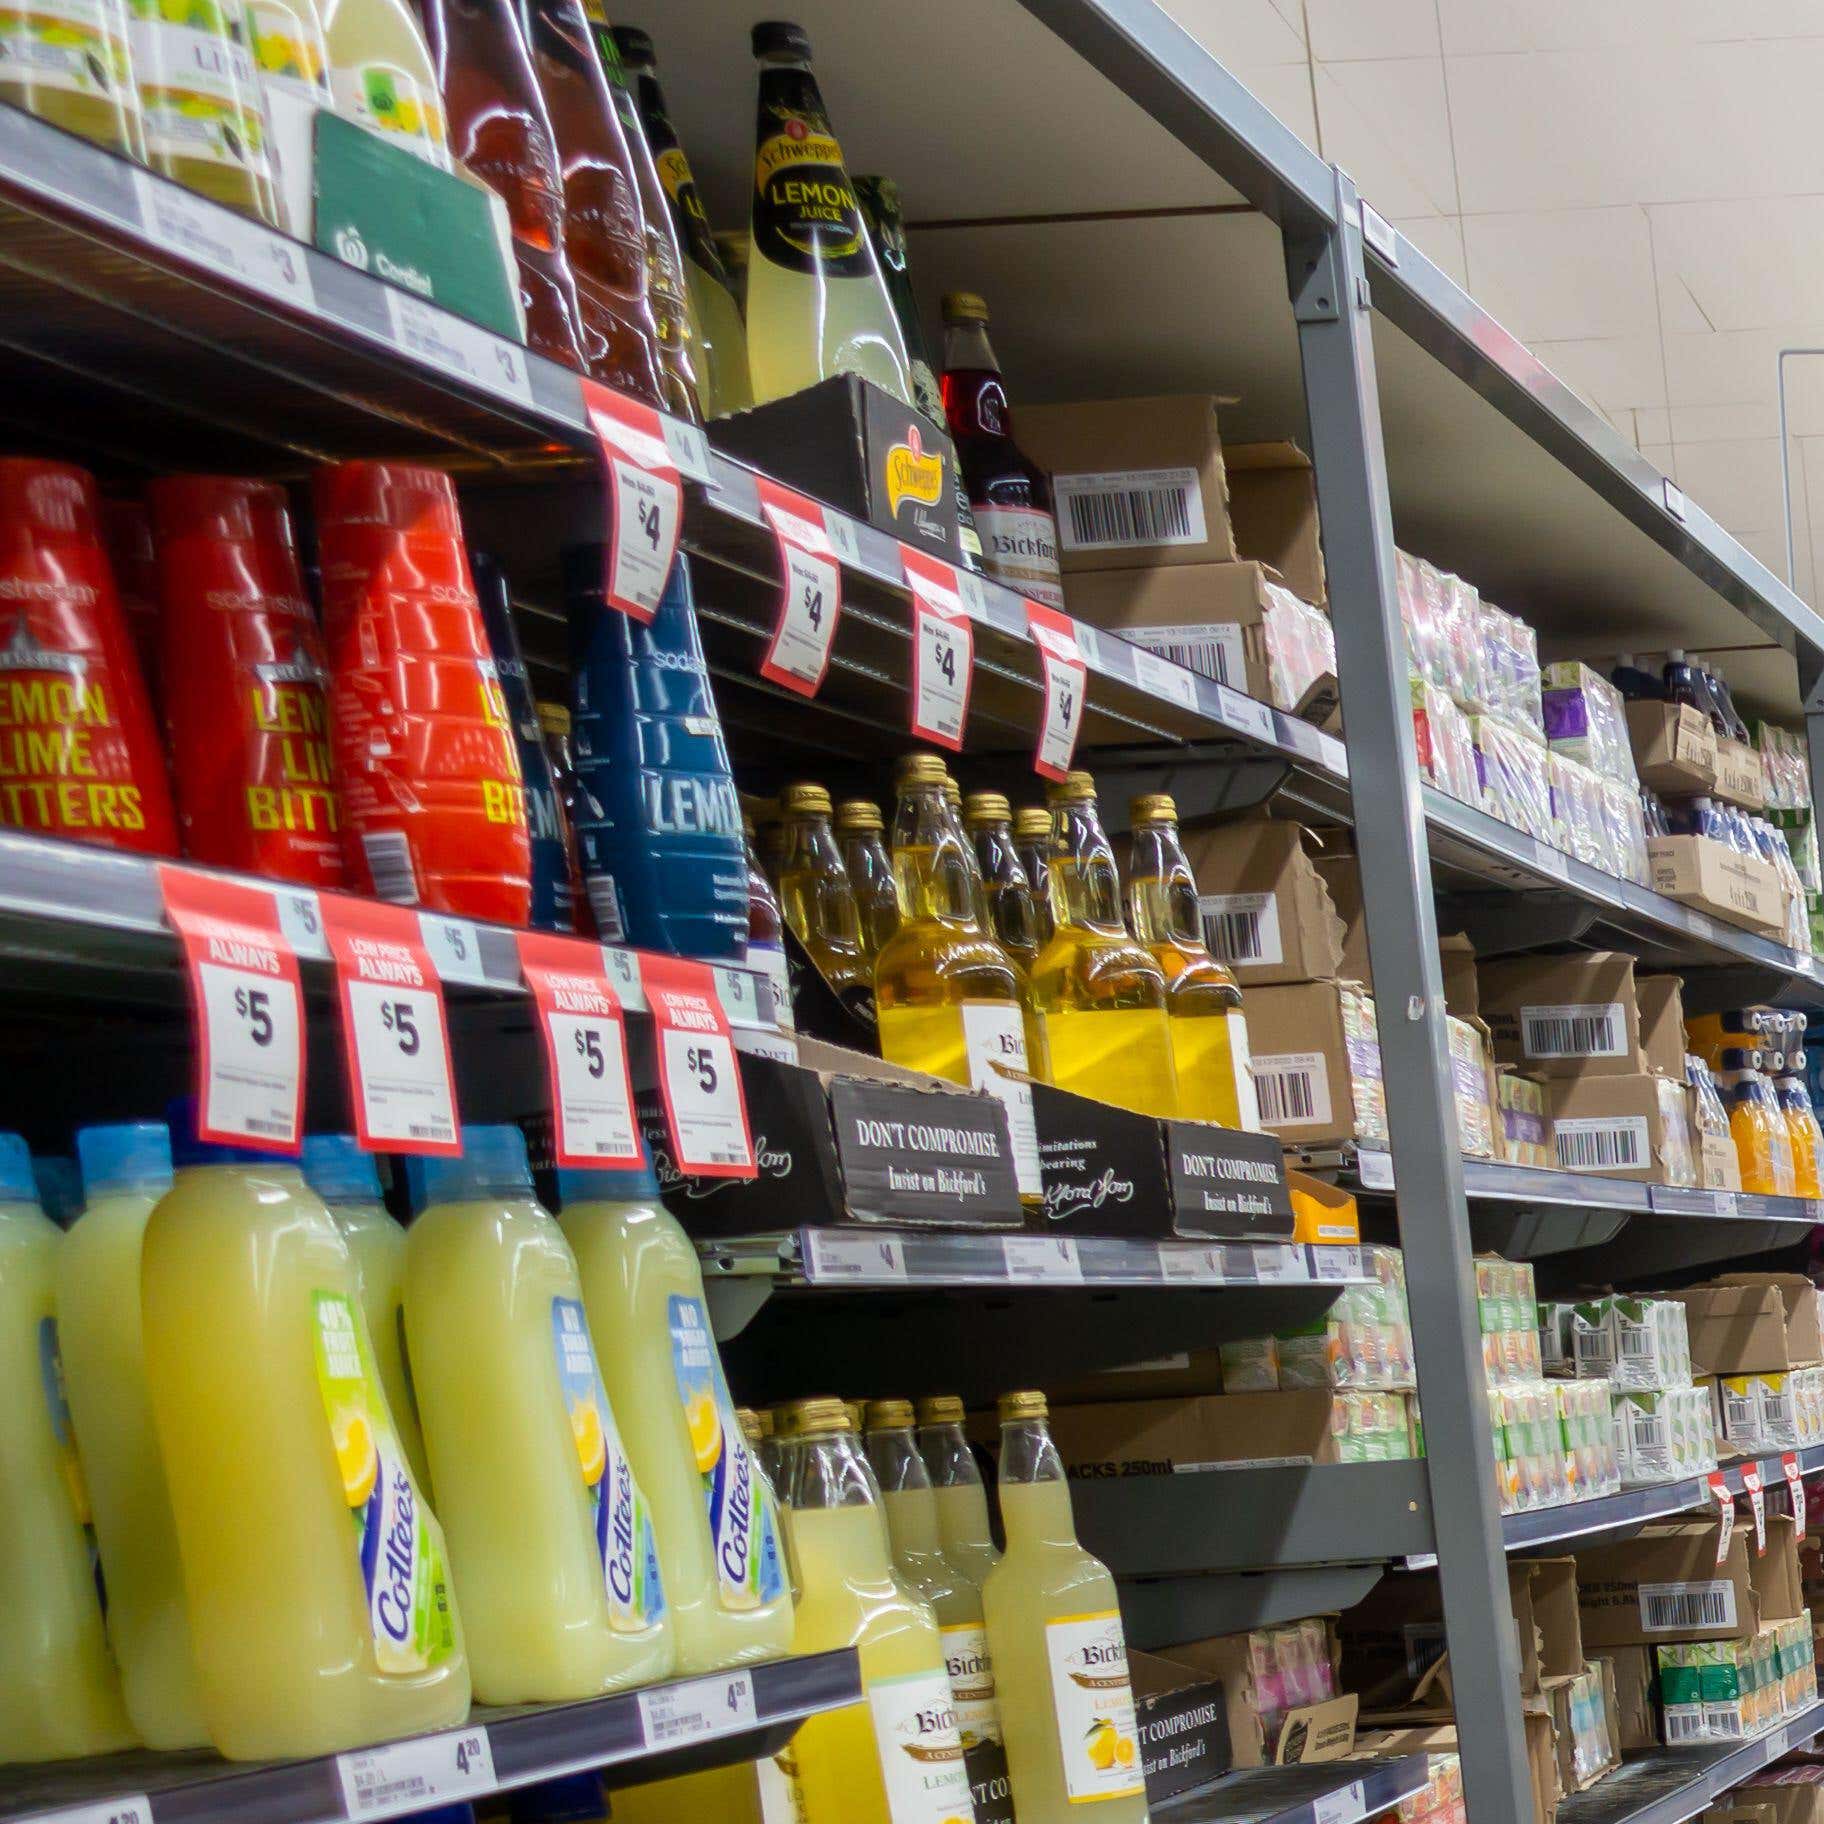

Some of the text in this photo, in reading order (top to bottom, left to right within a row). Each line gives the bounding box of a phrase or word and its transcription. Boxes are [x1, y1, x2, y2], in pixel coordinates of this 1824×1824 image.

[772, 182, 855, 211] LEMON
[799, 205, 842, 223] JUICE
[637, 496, 661, 551] $4
[804, 586, 822, 632] $4
[935, 648, 955, 686] $4
[1059, 689, 1072, 730] $4
[209, 939, 281, 975] ALWAYS
[358, 956, 424, 987] ALWAYS
[234, 987, 273, 1048] $5
[554, 988, 611, 1015] ALWAYS
[670, 1005, 719, 1031] ALWAYS
[382, 1001, 421, 1057] $5
[576, 1029, 605, 1079] $5
[688, 1047, 718, 1094] $5
[856, 1119, 1000, 1158] DON'T COMPROMISE
[1182, 1154, 1280, 1184] DON'T COMPROMISE
[1149, 1702, 1217, 1742] COMPROMISE
